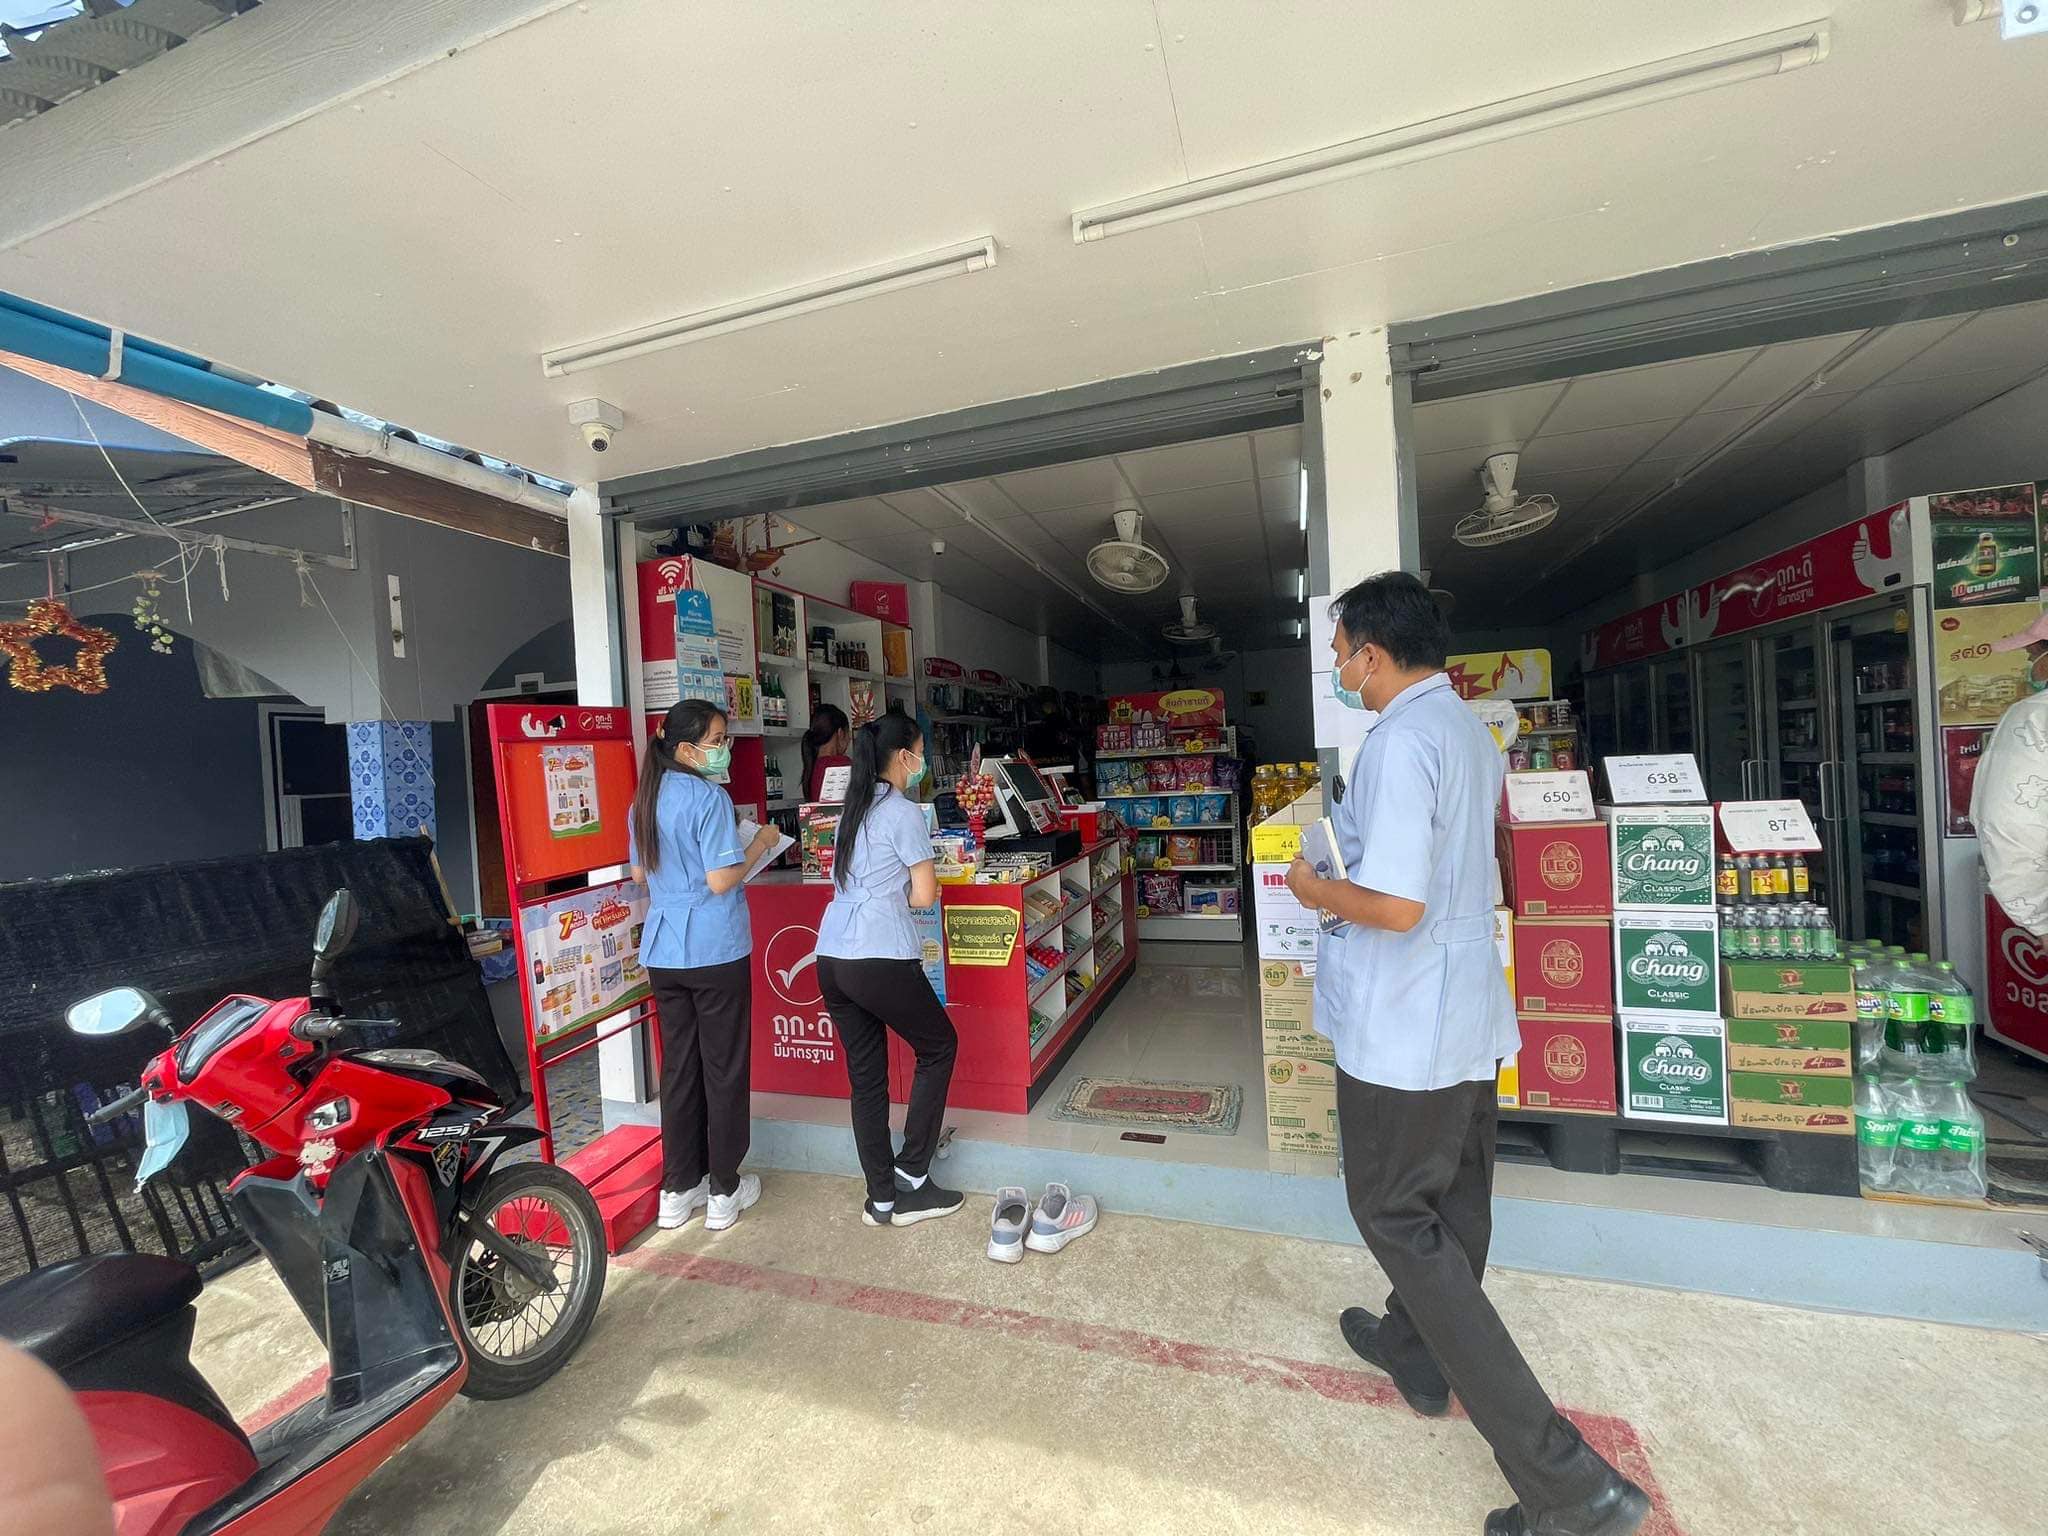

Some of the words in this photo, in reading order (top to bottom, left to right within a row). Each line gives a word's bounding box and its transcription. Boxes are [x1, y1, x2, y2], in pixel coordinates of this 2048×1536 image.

[1647, 772, 1679, 784] 638
[1543, 791, 1571, 803] 650
[1768, 819, 1788, 832] 87
[1281, 840, 1294, 849] 44
[1543, 859, 1580, 873] LEO
[1627, 853, 1700, 876] Chang
[560, 911, 574, 941] 7
[1543, 957, 1581, 972] LEO
[1630, 957, 1704, 981] Chang
[1265, 967, 1286, 979] ลีลา
[1647, 988, 1690, 1000] CLASSIC
[773, 1041, 835, 1065] มีมาตรฐาน
[1546, 1051, 1584, 1067] LEO
[1269, 1065, 1290, 1079] ลีลา
[1642, 1057, 1707, 1081] Chang
[417, 1123, 471, 1140] 125i
